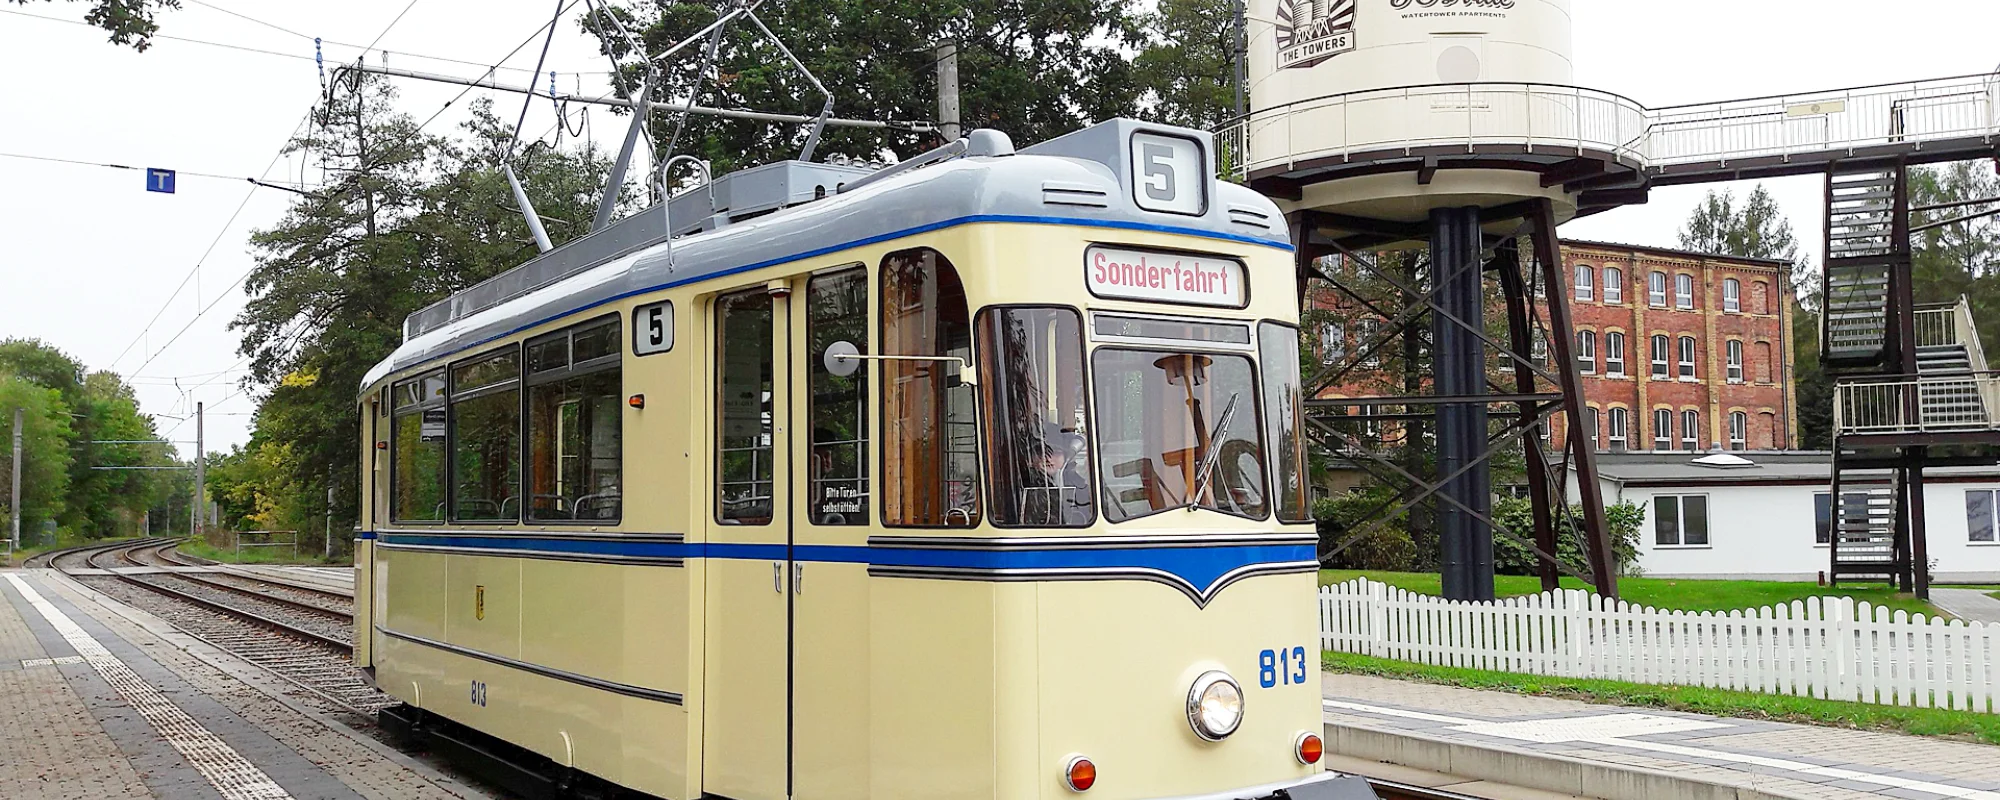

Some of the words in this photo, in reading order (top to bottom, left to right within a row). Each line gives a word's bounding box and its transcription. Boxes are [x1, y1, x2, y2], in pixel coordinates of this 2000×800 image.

[1401, 11, 1456, 19] WATERTOWER
[1283, 48, 1299, 63] THE
[1302, 36, 1346, 57] TOWERS
[152, 171, 170, 190] T
[1143, 142, 1176, 202] 5
[1094, 252, 1228, 295] Sonderfahrt
[649, 306, 663, 346] 5
[1259, 645, 1306, 689] 813
[471, 680, 487, 707] 813
